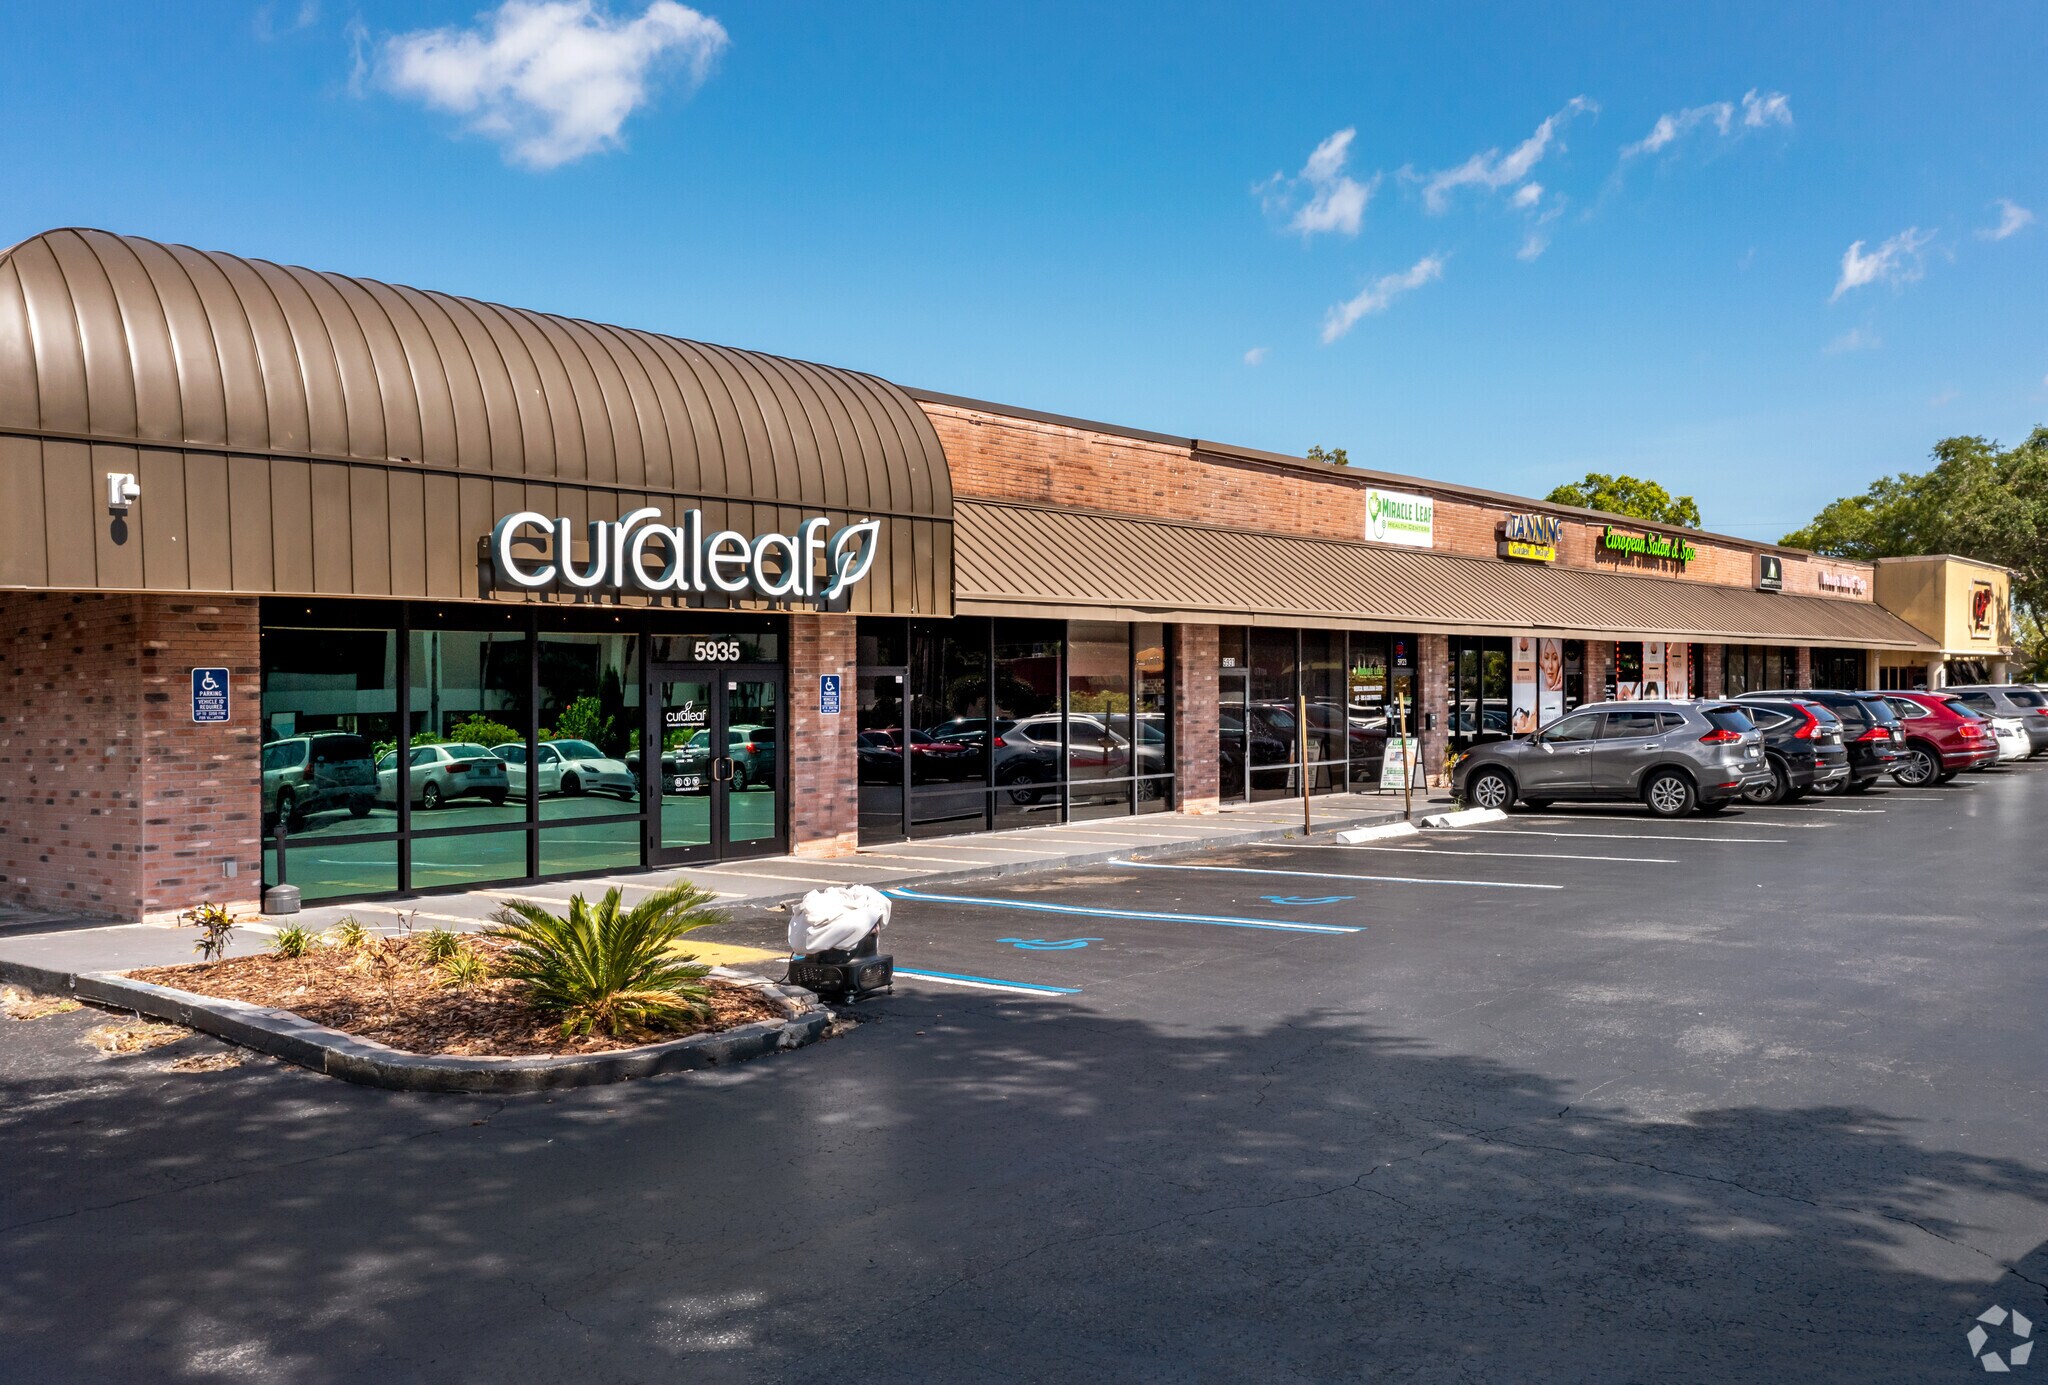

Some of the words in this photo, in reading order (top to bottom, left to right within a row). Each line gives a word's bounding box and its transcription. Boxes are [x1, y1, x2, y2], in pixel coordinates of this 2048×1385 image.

[1506, 512, 1562, 545] TANNING
[494, 507, 830, 597] curaleaf
[1606, 525, 1645, 558] European
[1646, 532, 1670, 557] Salon
[1671, 538, 1679, 559] &
[1680, 539, 1695, 566] Spa
[694, 641, 740, 662] 5935
[666, 709, 707, 722] curaleaf
